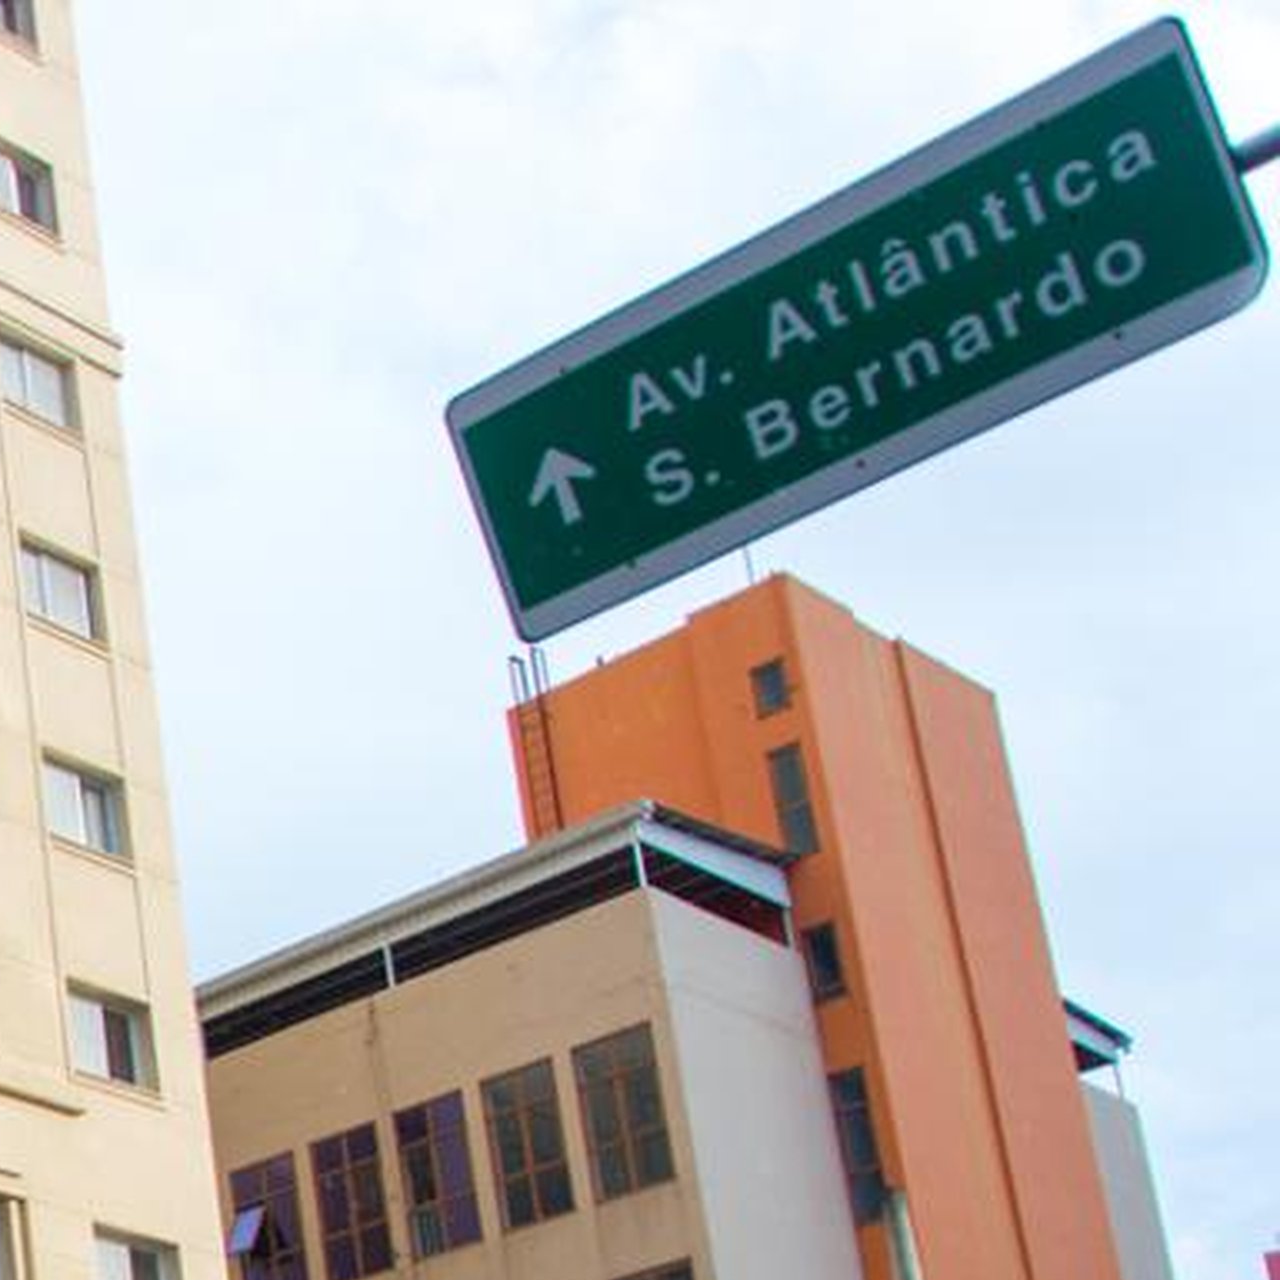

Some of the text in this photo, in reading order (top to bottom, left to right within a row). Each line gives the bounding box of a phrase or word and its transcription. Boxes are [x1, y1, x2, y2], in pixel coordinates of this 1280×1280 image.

[627, 127, 1157, 431] Av. Atlântica
[644, 238, 1147, 505] S. Bernardo
